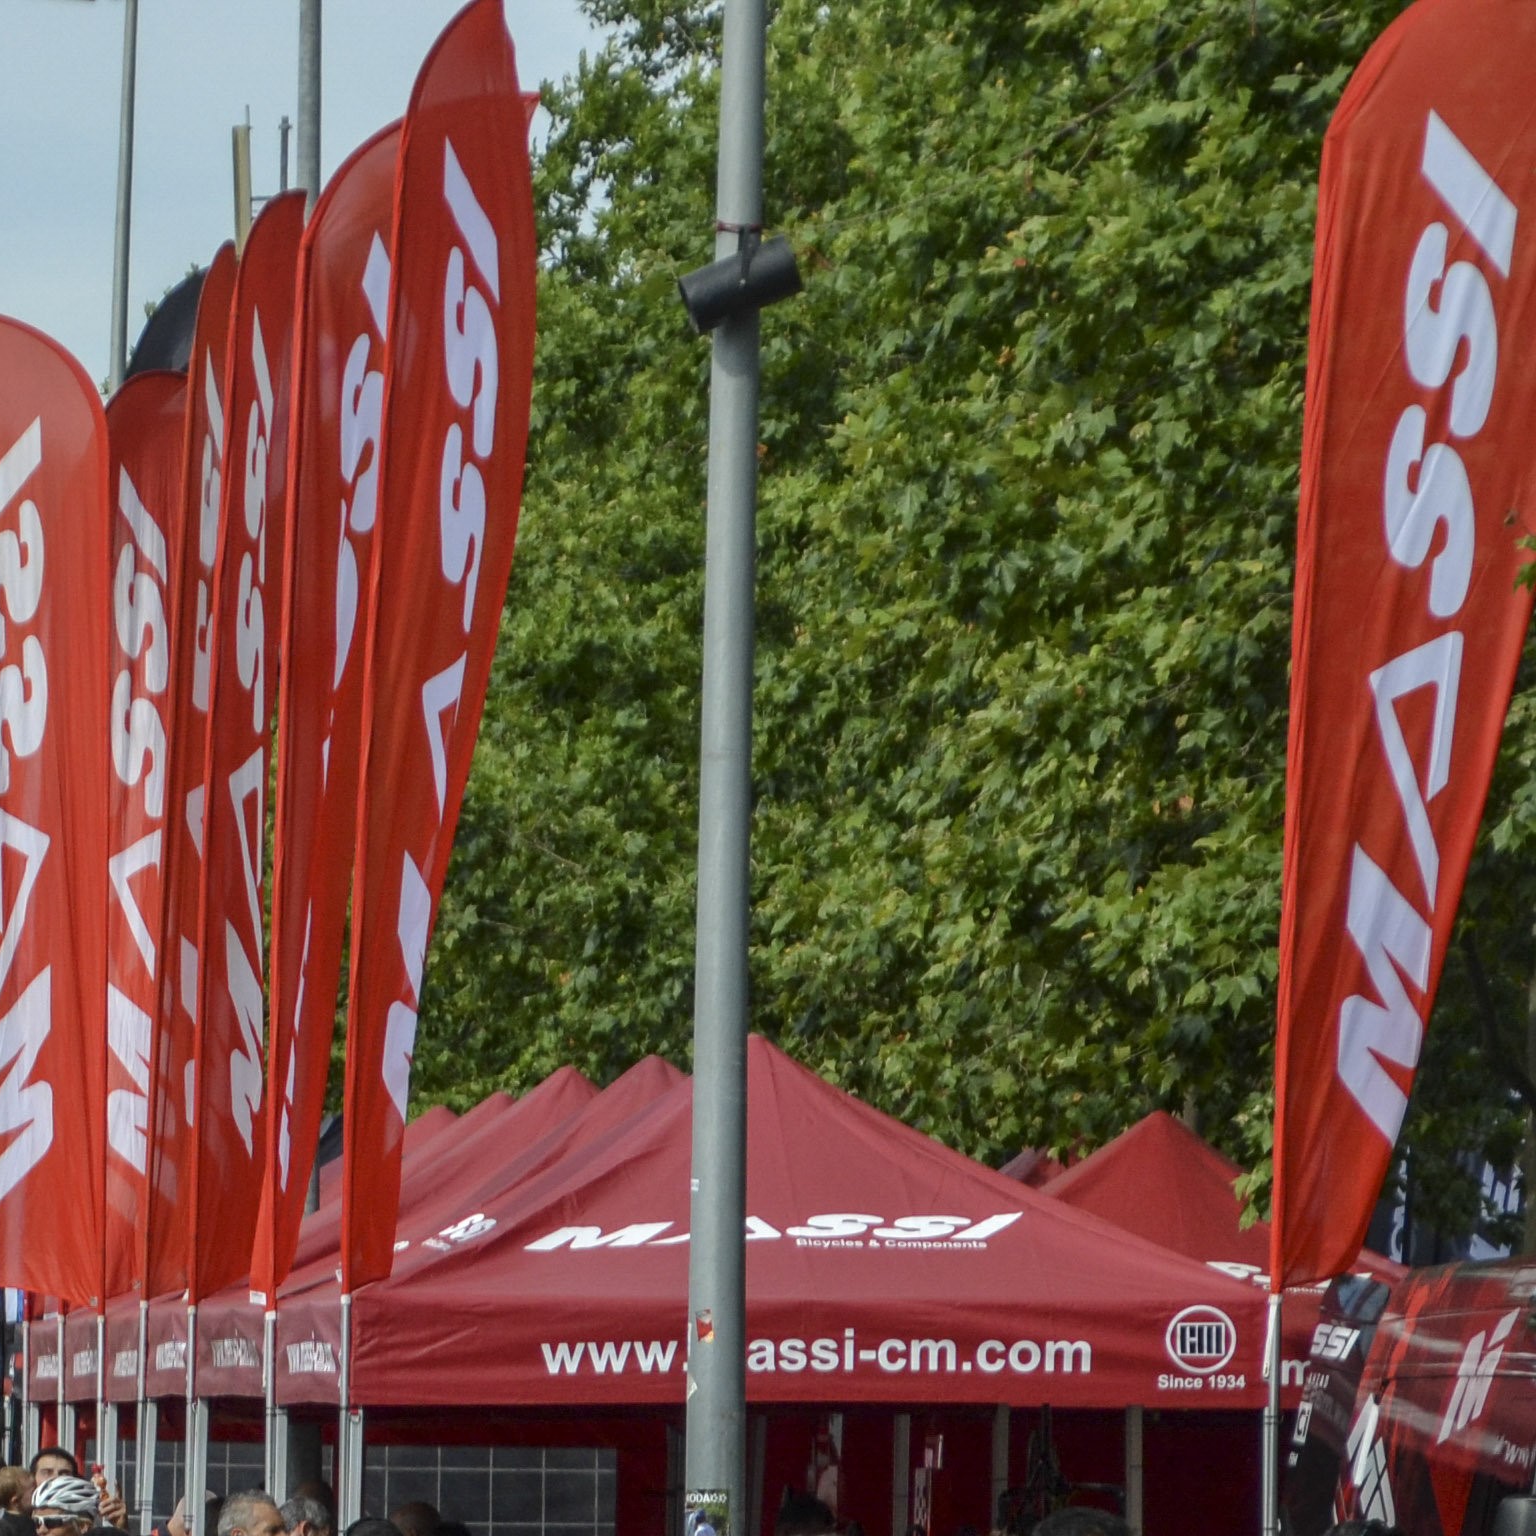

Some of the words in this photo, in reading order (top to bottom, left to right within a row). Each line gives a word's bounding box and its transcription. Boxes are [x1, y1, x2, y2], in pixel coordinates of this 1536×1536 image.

[1337, 109, 1518, 1148] MASSI
[795, 1237, 864, 1249] Bicycles
[869, 1237, 881, 1249] &
[885, 1238, 988, 1250] Components
[541, 1328, 1092, 1375] www.assi-cm.com
[1157, 1374, 1203, 1389] Since
[1208, 1374, 1247, 1389] 1934
